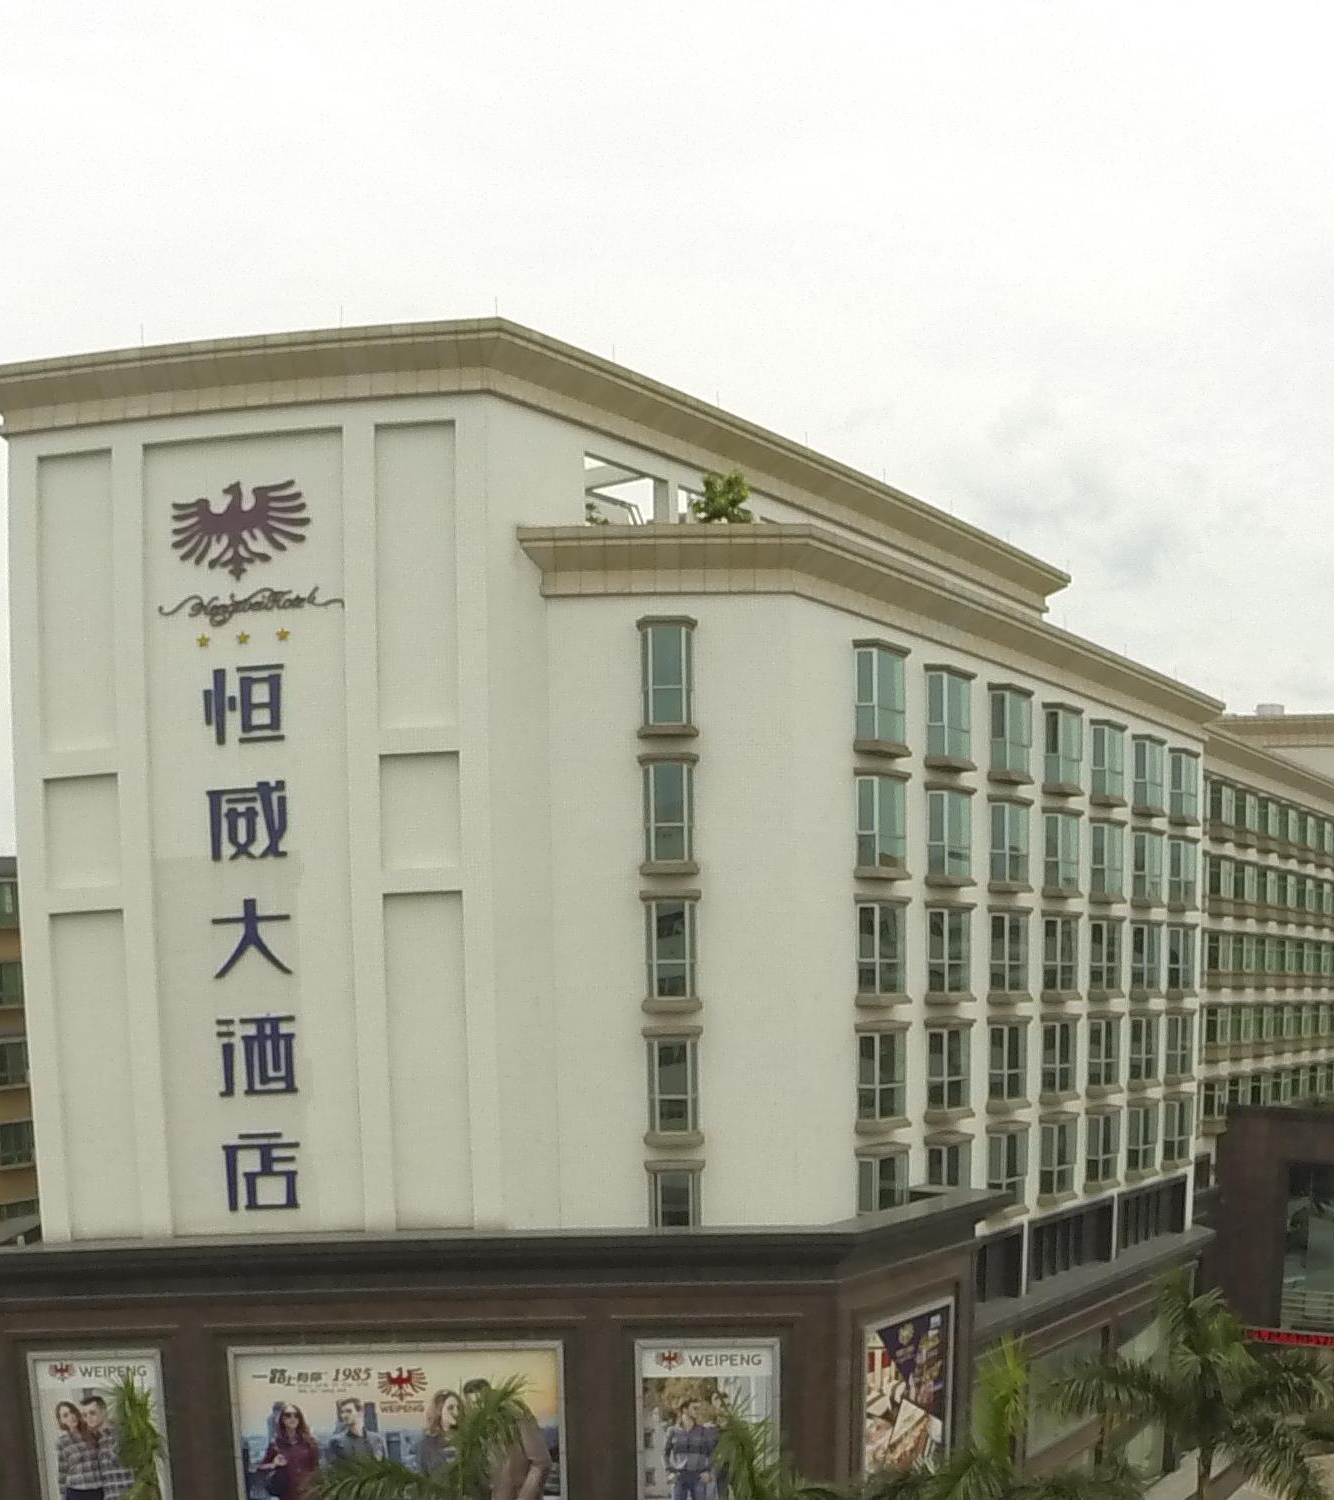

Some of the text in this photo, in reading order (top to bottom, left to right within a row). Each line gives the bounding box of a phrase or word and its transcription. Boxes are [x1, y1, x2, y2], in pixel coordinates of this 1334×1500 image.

[203, 663, 301, 1212] 恒威大酒店
[689, 1353, 762, 1366] WEIPENG
[79, 1365, 147, 1377] WEIPENG
[332, 1368, 372, 1382] 1985
[380, 1403, 425, 1414] WEIPENG
